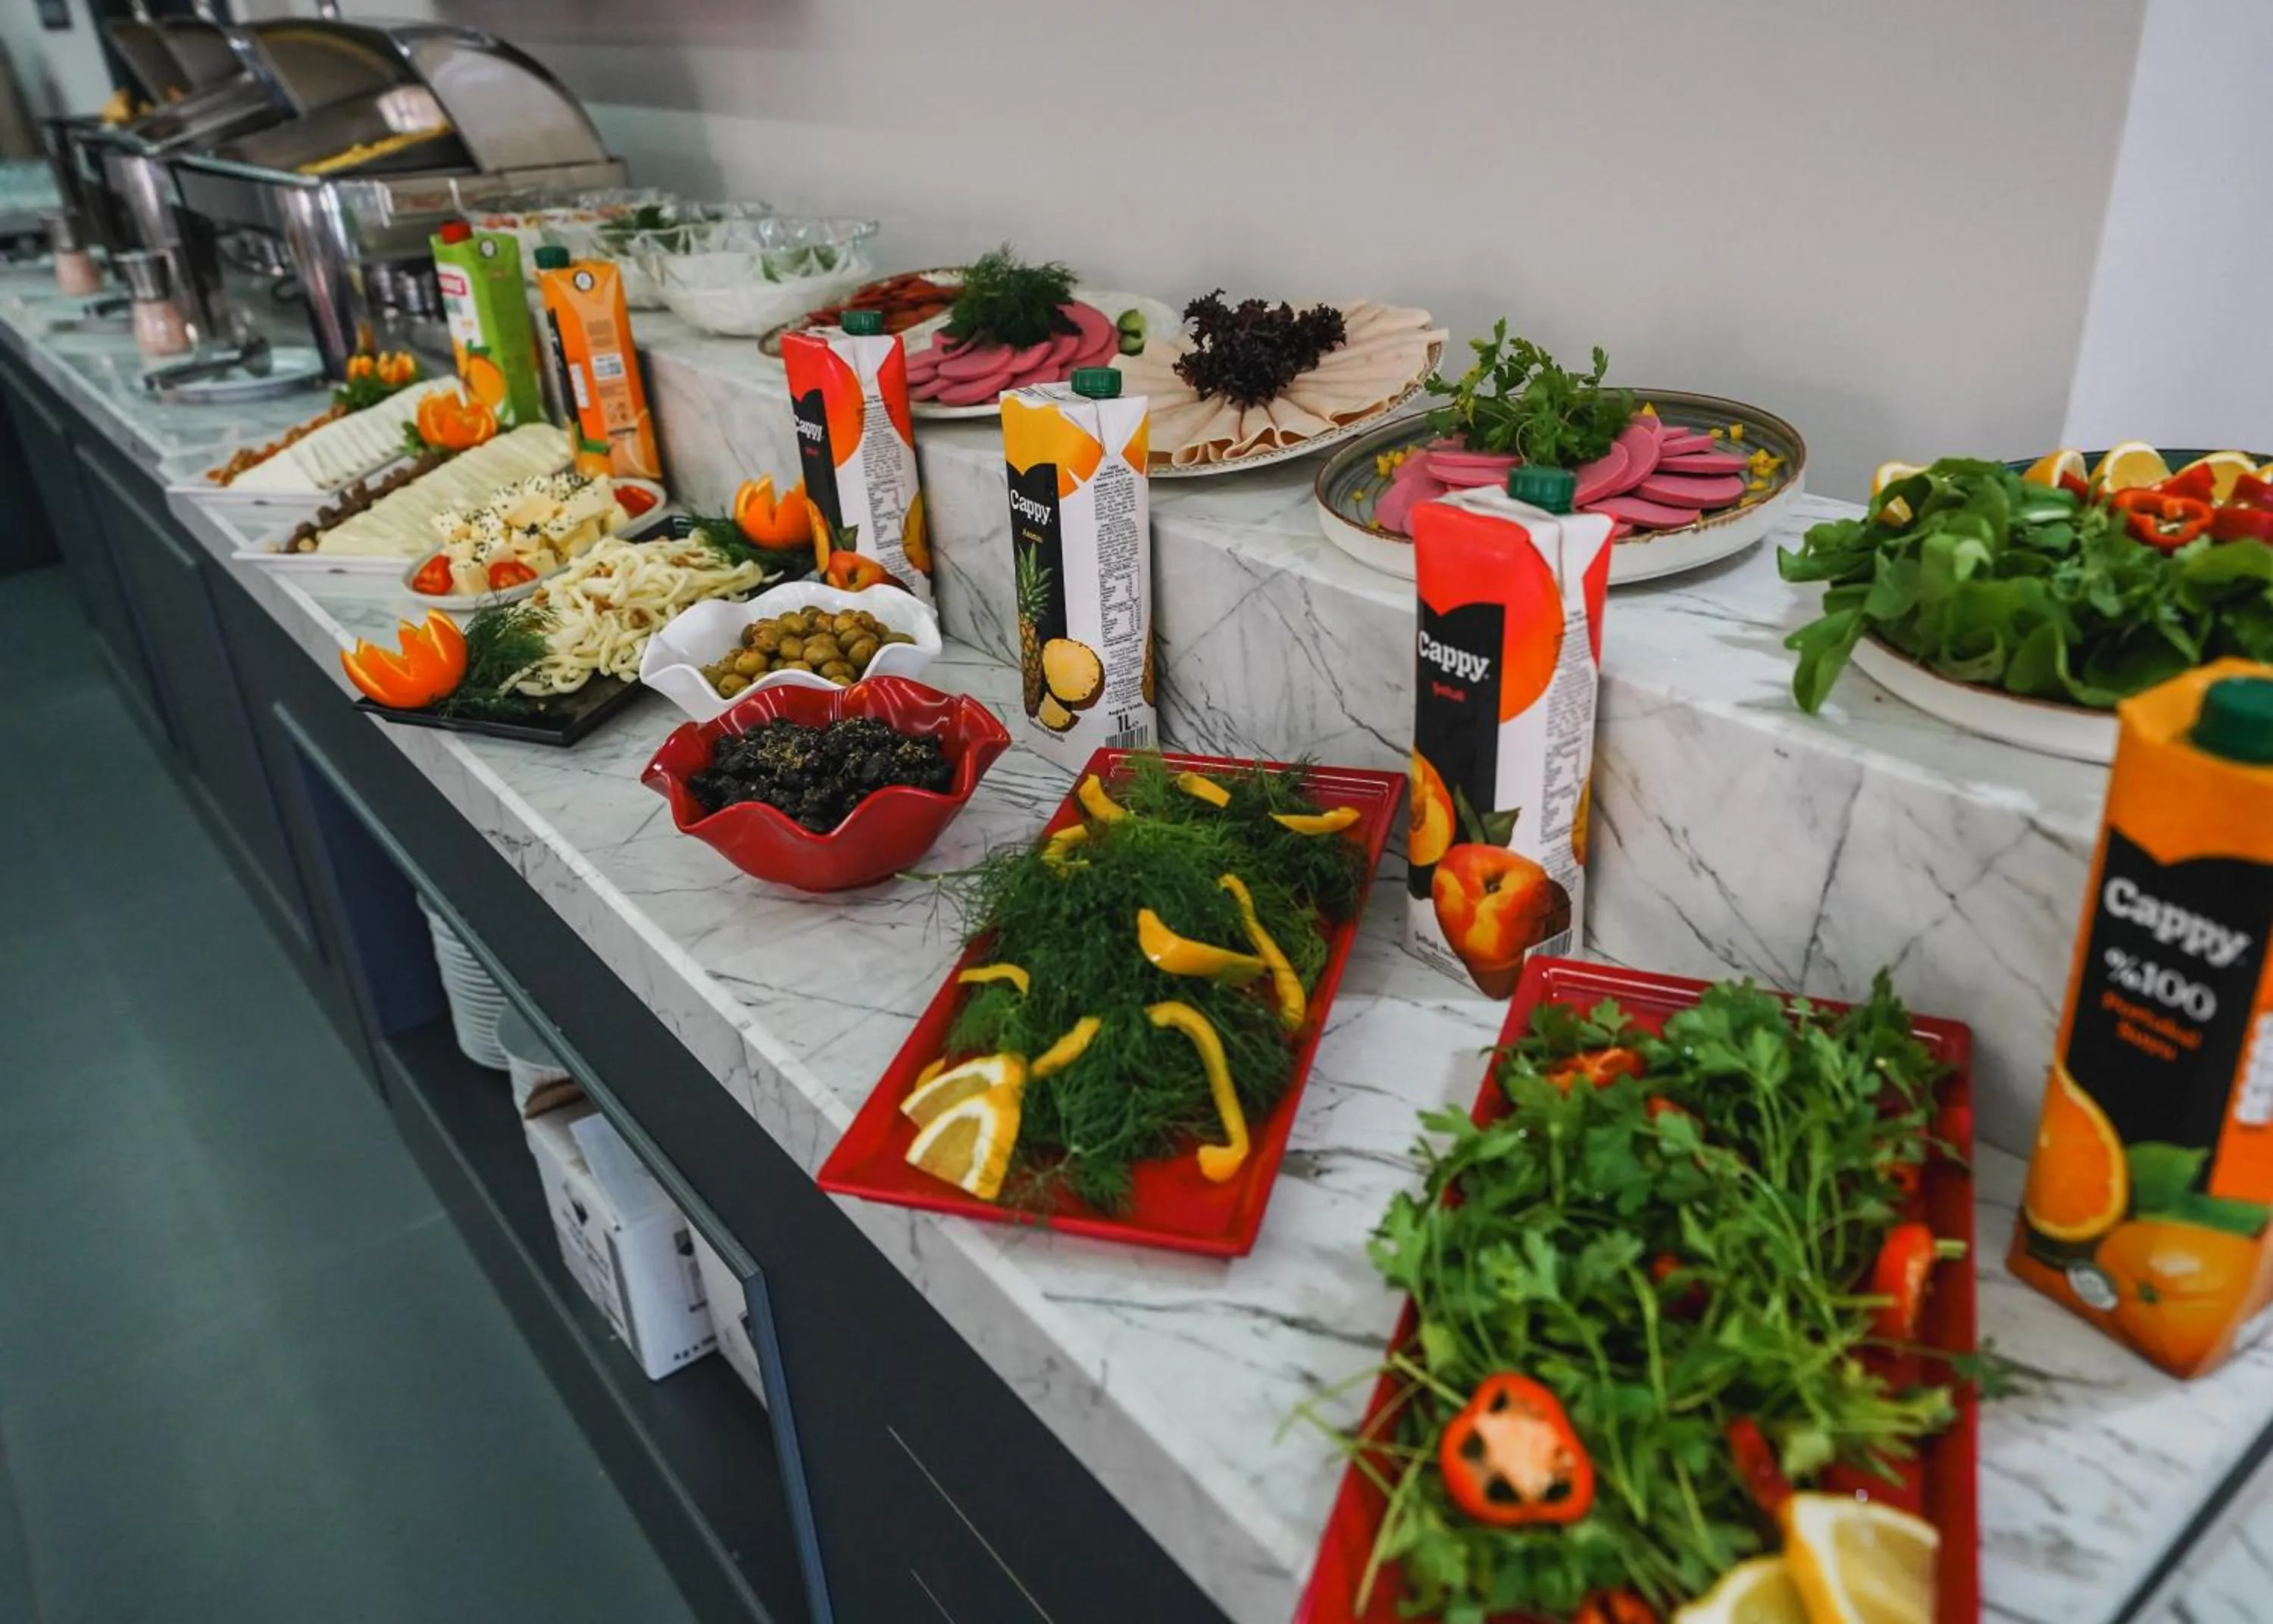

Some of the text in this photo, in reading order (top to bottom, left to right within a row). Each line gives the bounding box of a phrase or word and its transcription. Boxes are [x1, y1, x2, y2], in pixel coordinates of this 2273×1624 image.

[1010, 489, 1052, 525] Cappy
[1418, 629, 1490, 682] Cappy
[2103, 876, 2253, 969] Cappy
[2103, 947, 2218, 1023] %100
